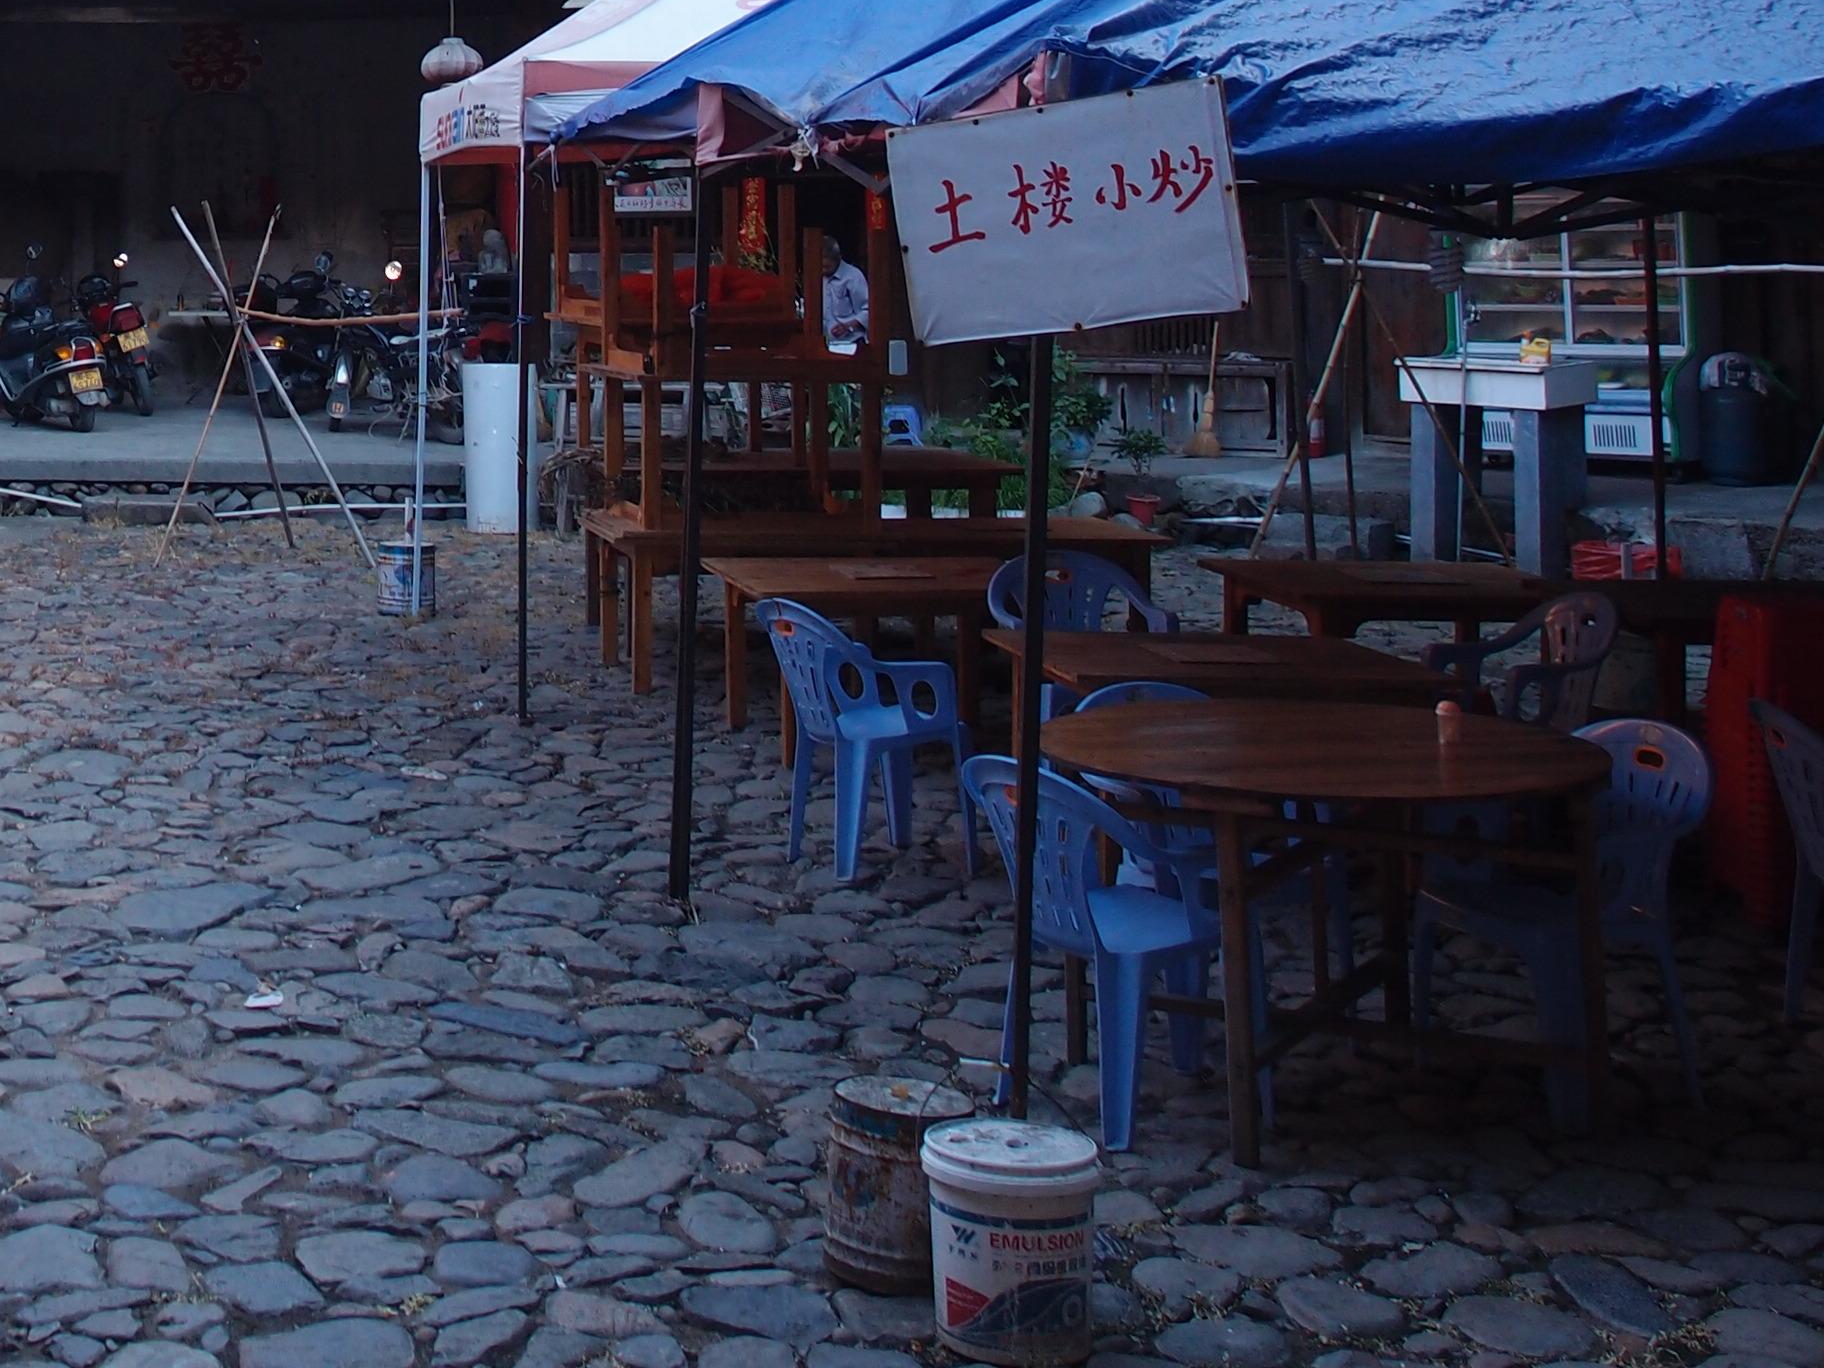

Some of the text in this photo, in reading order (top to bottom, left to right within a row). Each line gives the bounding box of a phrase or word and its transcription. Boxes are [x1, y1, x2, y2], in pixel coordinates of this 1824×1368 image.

[928, 144, 1215, 254] 土楼小炒
[989, 1229, 1085, 1253] EMULSION
